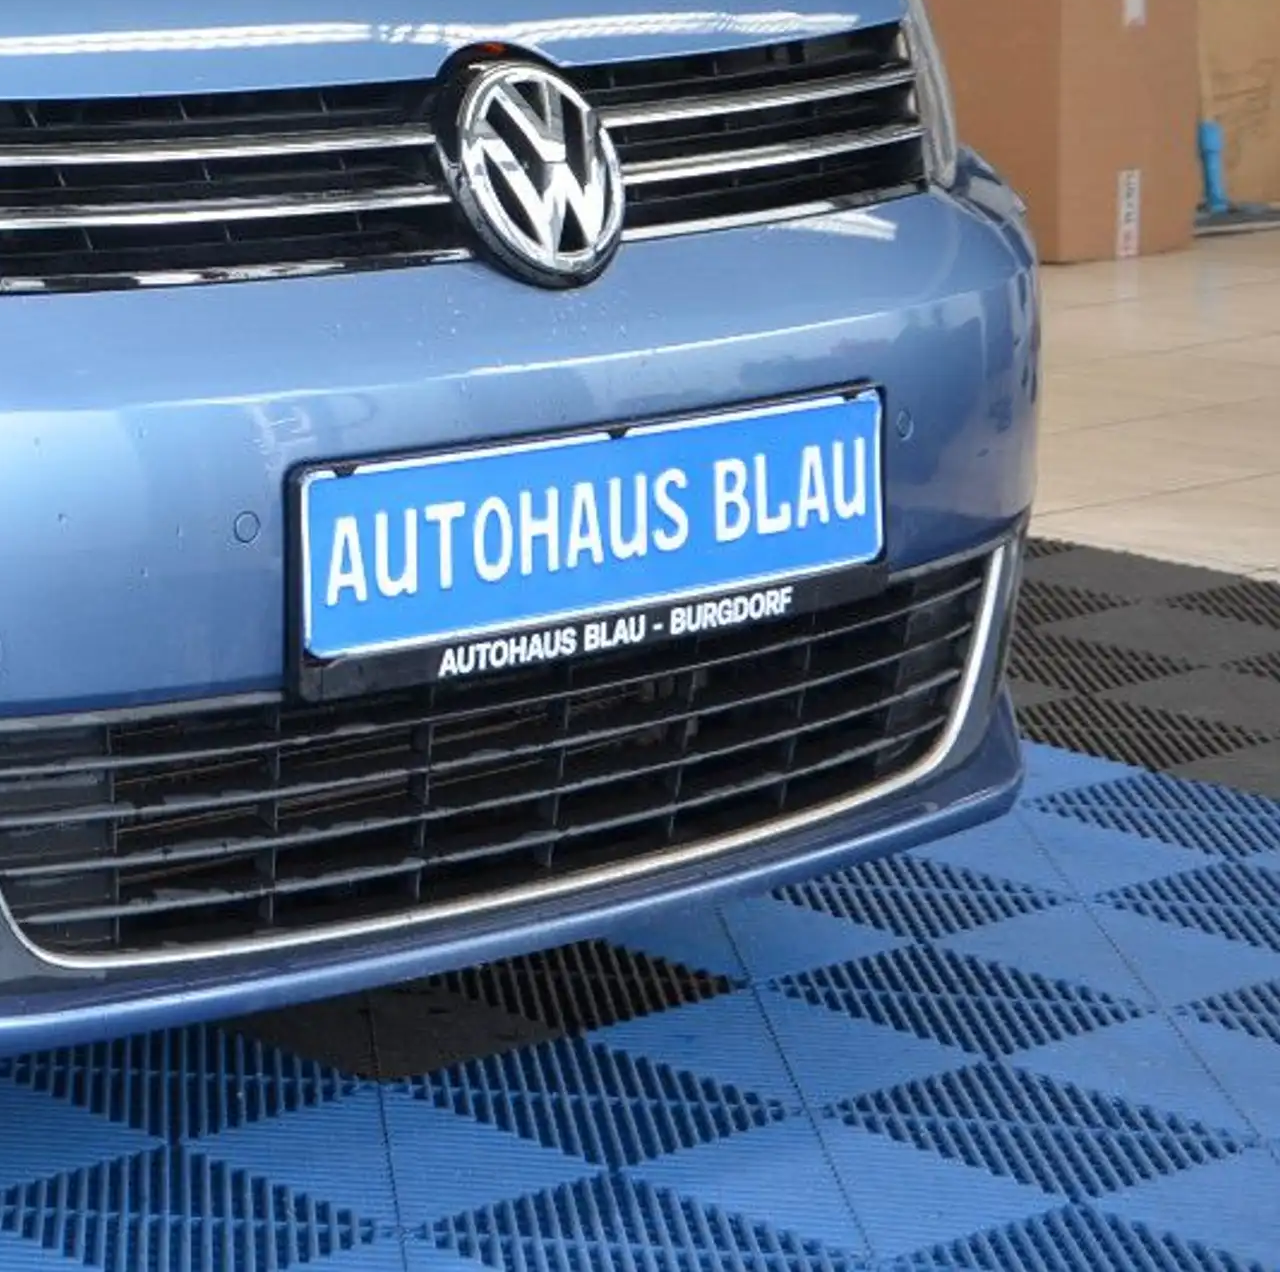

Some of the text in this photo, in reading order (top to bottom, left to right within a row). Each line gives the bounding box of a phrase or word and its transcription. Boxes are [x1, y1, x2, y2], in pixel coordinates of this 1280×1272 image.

[325, 436, 868, 607] AUTOHAUS BLAU
[437, 626, 577, 678] AUTOHAUS
[583, 613, 646, 652] BLAU
[669, 586, 794, 636] BURGDORF
